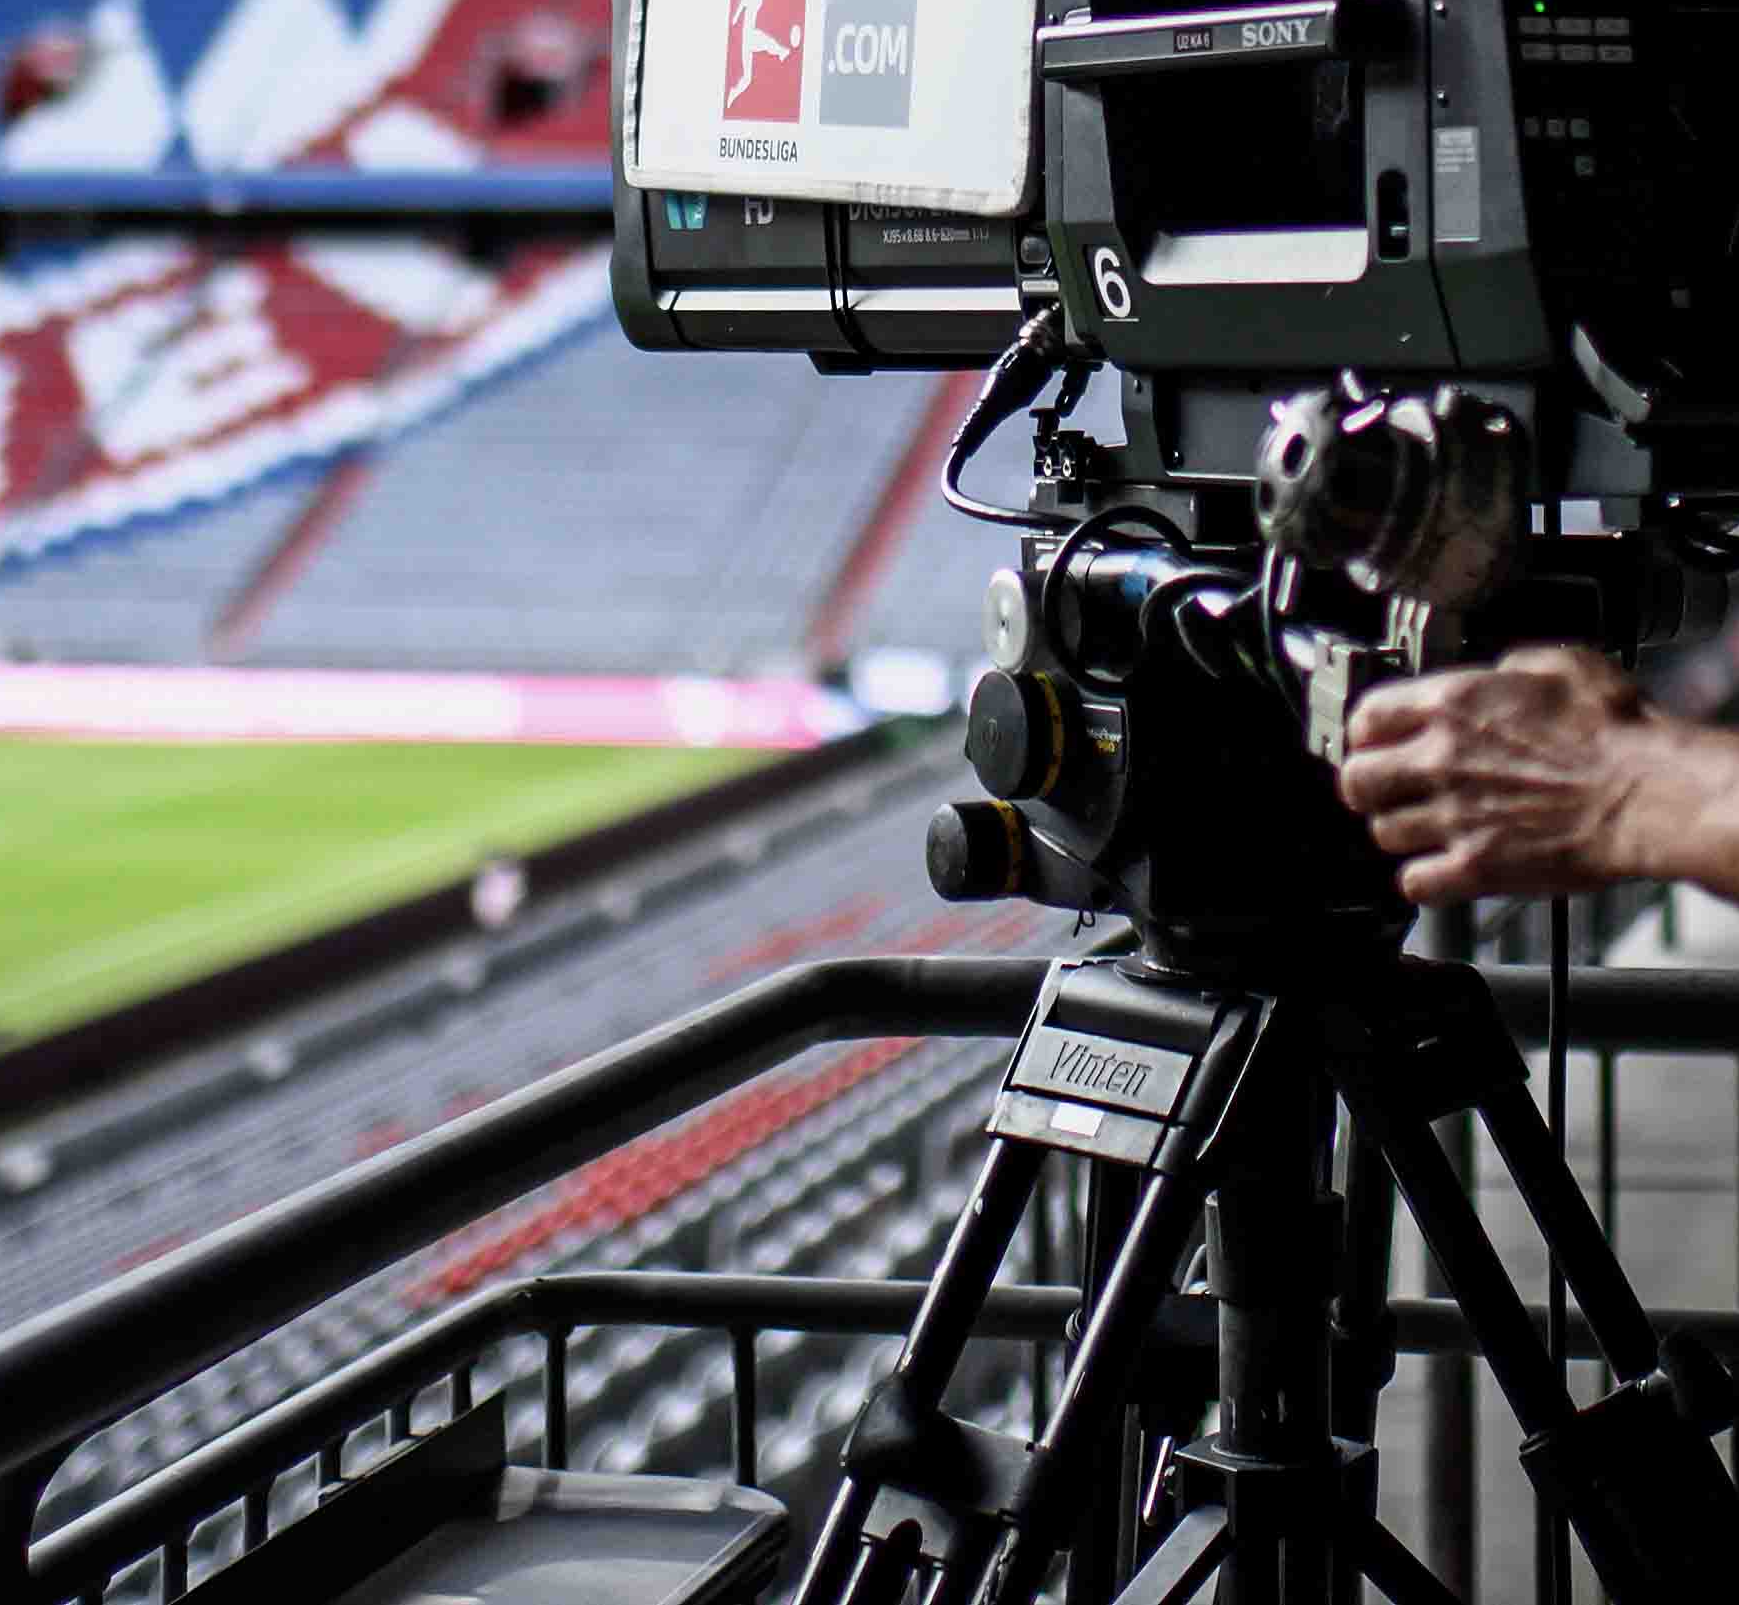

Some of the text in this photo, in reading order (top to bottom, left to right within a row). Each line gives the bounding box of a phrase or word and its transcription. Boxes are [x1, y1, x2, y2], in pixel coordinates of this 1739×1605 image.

[827, 23, 909, 76] .COM
[1241, 19, 1311, 48] SONY
[719, 137, 799, 164] BUNDESLIGA
[1094, 246, 1130, 318] 6
[1046, 1039, 1154, 1097] Vinten
